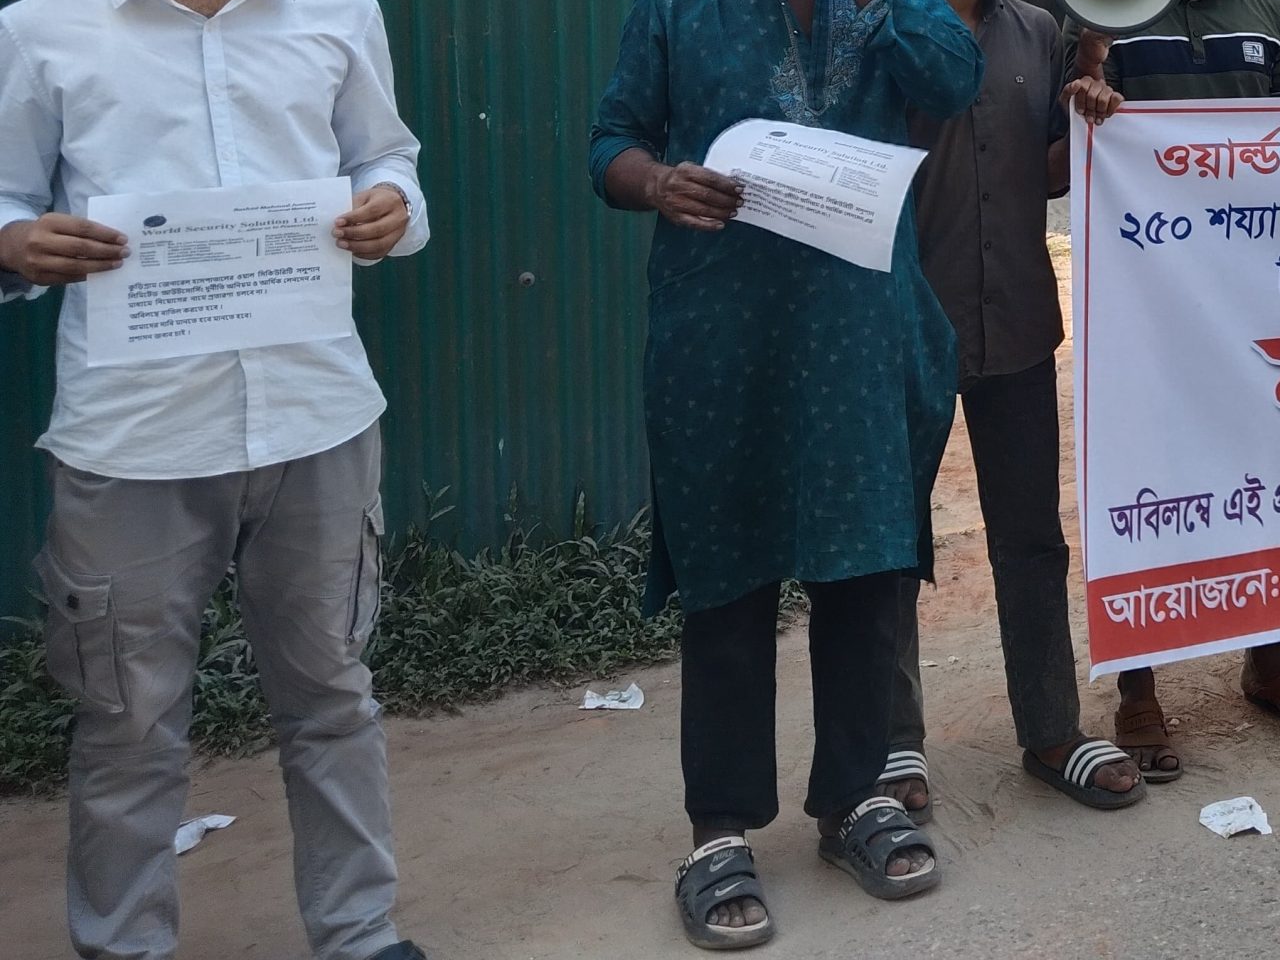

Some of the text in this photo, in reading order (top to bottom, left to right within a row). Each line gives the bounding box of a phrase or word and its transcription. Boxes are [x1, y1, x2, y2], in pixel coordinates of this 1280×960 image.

[141, 226, 181, 236] World
[186, 223, 237, 233] Security
[240, 218, 289, 228] Solution
[1120, 211, 1192, 250] ২৫০
[1108, 488, 1214, 542] অবিলম্বে
[1224, 473, 1266, 526] এই
